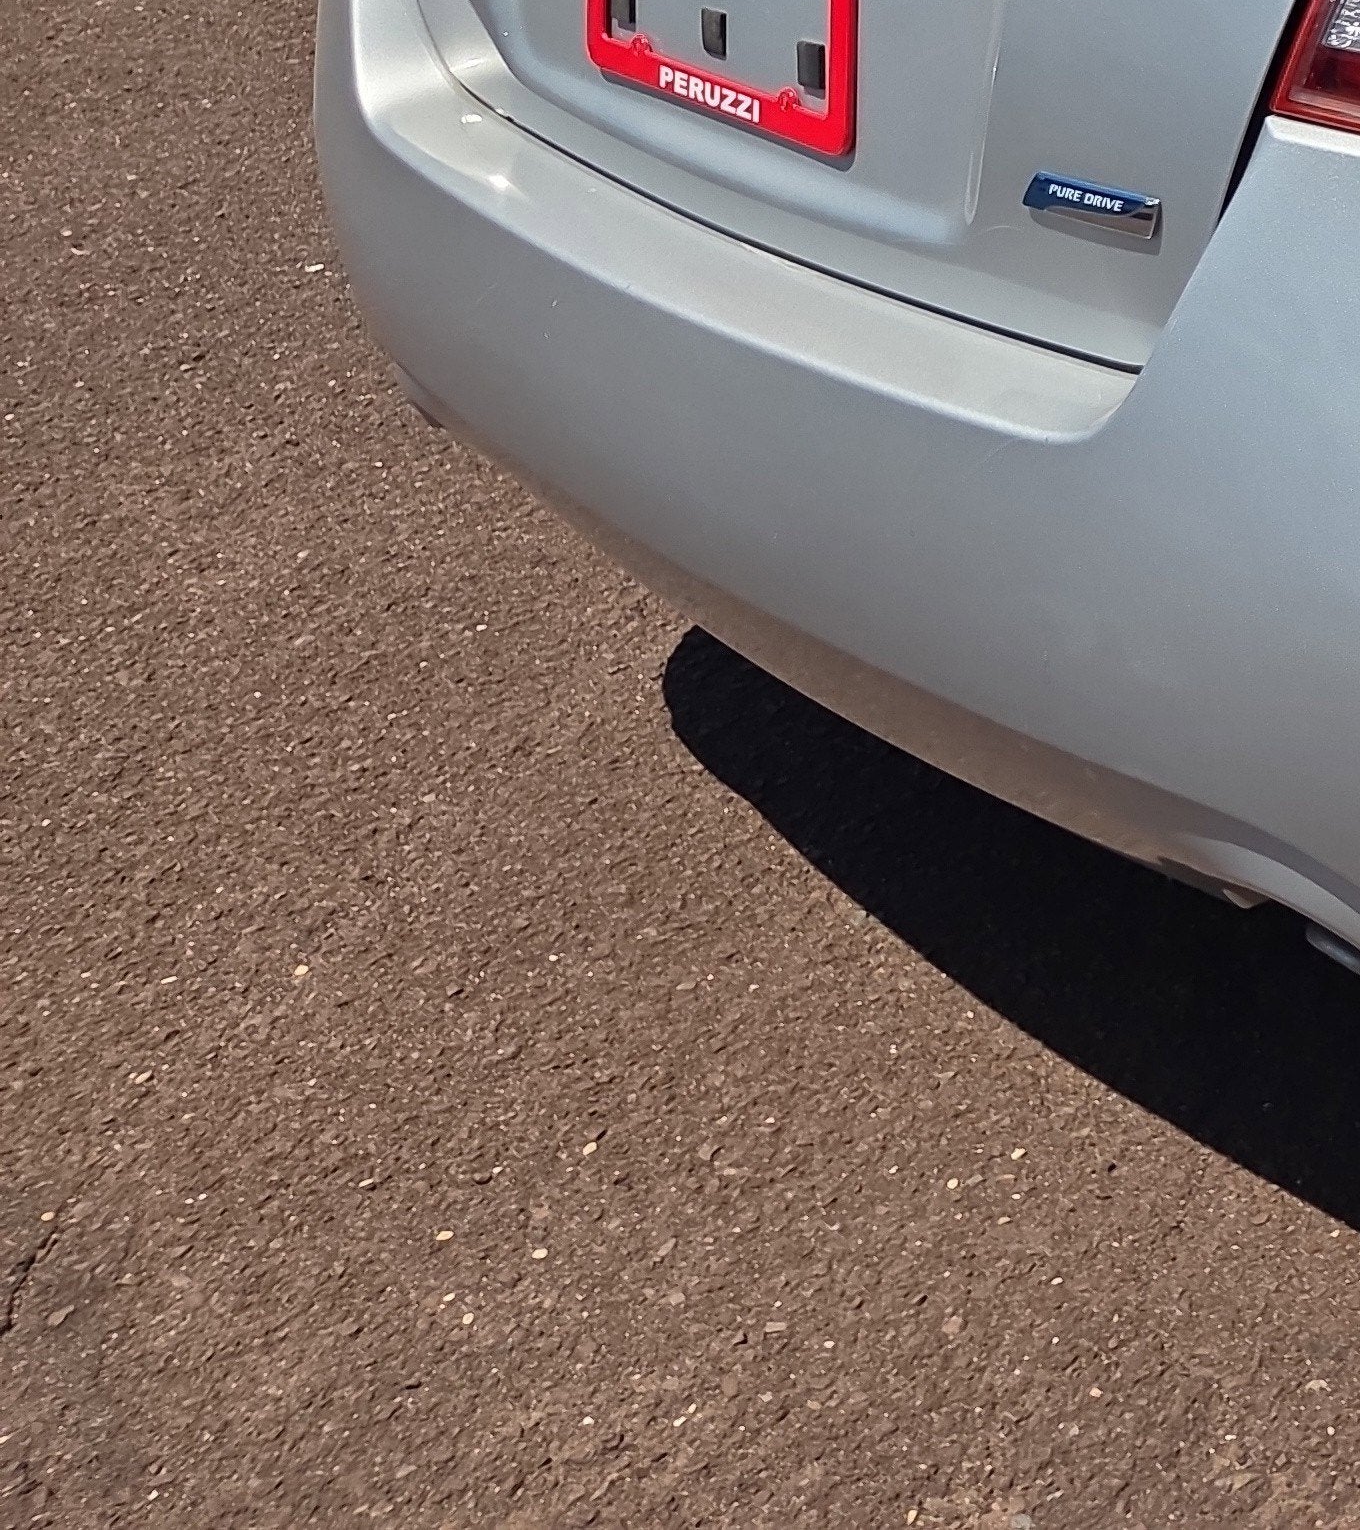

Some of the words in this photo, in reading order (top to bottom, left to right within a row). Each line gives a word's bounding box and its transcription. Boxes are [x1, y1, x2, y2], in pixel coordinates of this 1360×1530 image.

[658, 64, 760, 124] PERUZZI
[1048, 183, 1082, 202] PURE
[1083, 192, 1125, 212] DRIVE
